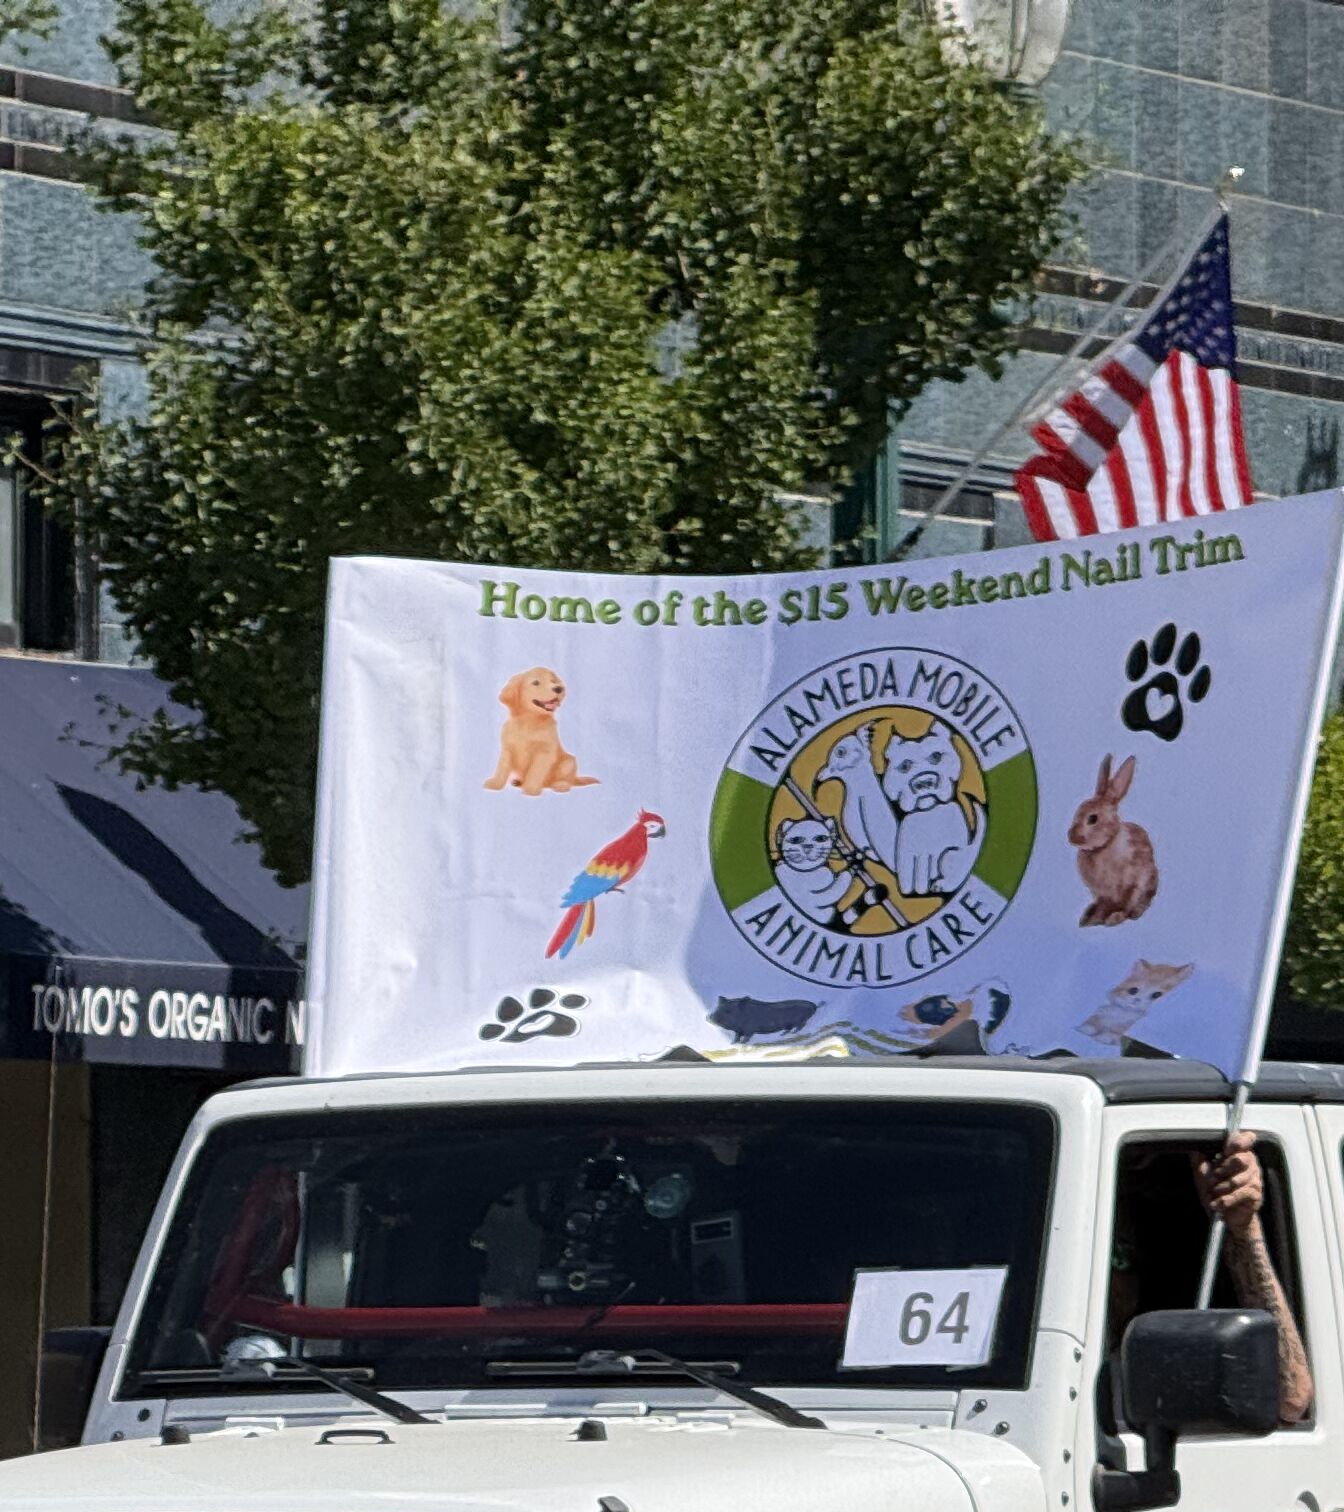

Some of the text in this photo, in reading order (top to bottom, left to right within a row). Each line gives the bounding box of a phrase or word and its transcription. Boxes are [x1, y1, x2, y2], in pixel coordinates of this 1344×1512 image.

[477, 528, 1246, 628] Home of the $15 Weekend Nail Trim
[747, 657, 1016, 773] ALAMEDA MOBILE
[744, 891, 995, 983] ANIMAL CARE
[30, 984, 141, 1038] TOMO'S
[147, 989, 277, 1045] ORGANIC
[898, 1291, 970, 1346] 64
